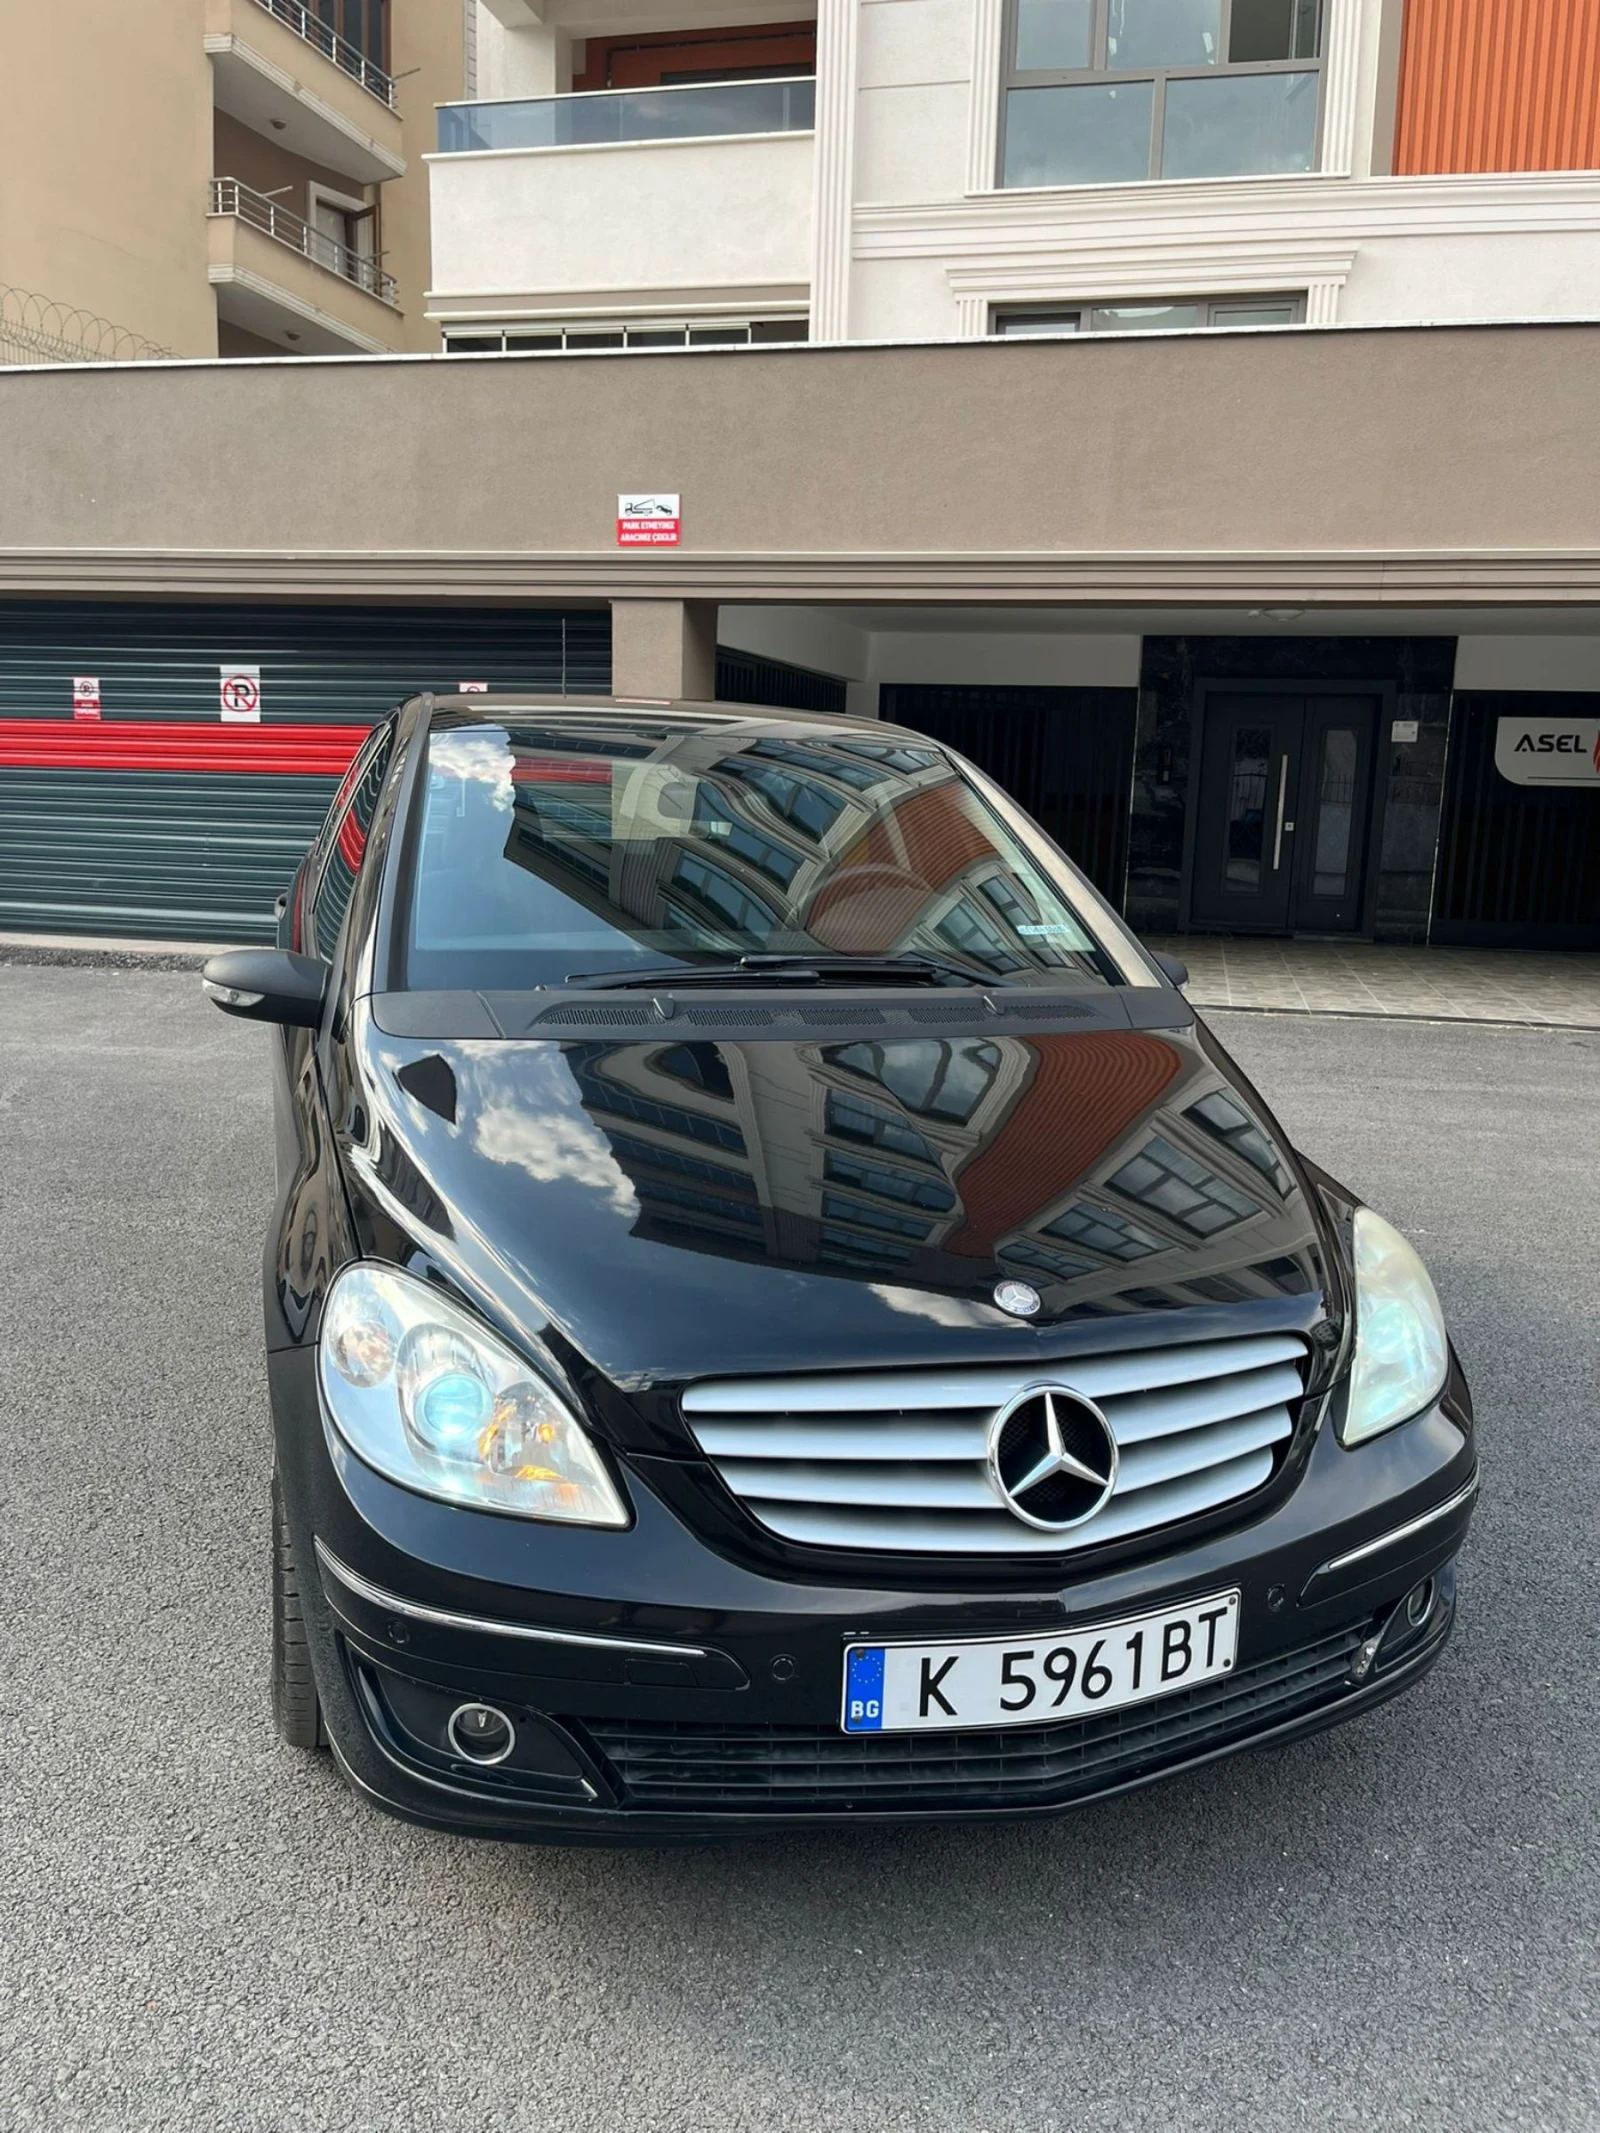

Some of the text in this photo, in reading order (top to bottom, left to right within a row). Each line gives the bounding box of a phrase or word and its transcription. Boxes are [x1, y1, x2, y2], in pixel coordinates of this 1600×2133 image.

[1514, 733, 1588, 753] ASEL
[918, 1655, 960, 1718] K
[850, 1699, 880, 1719] BG
